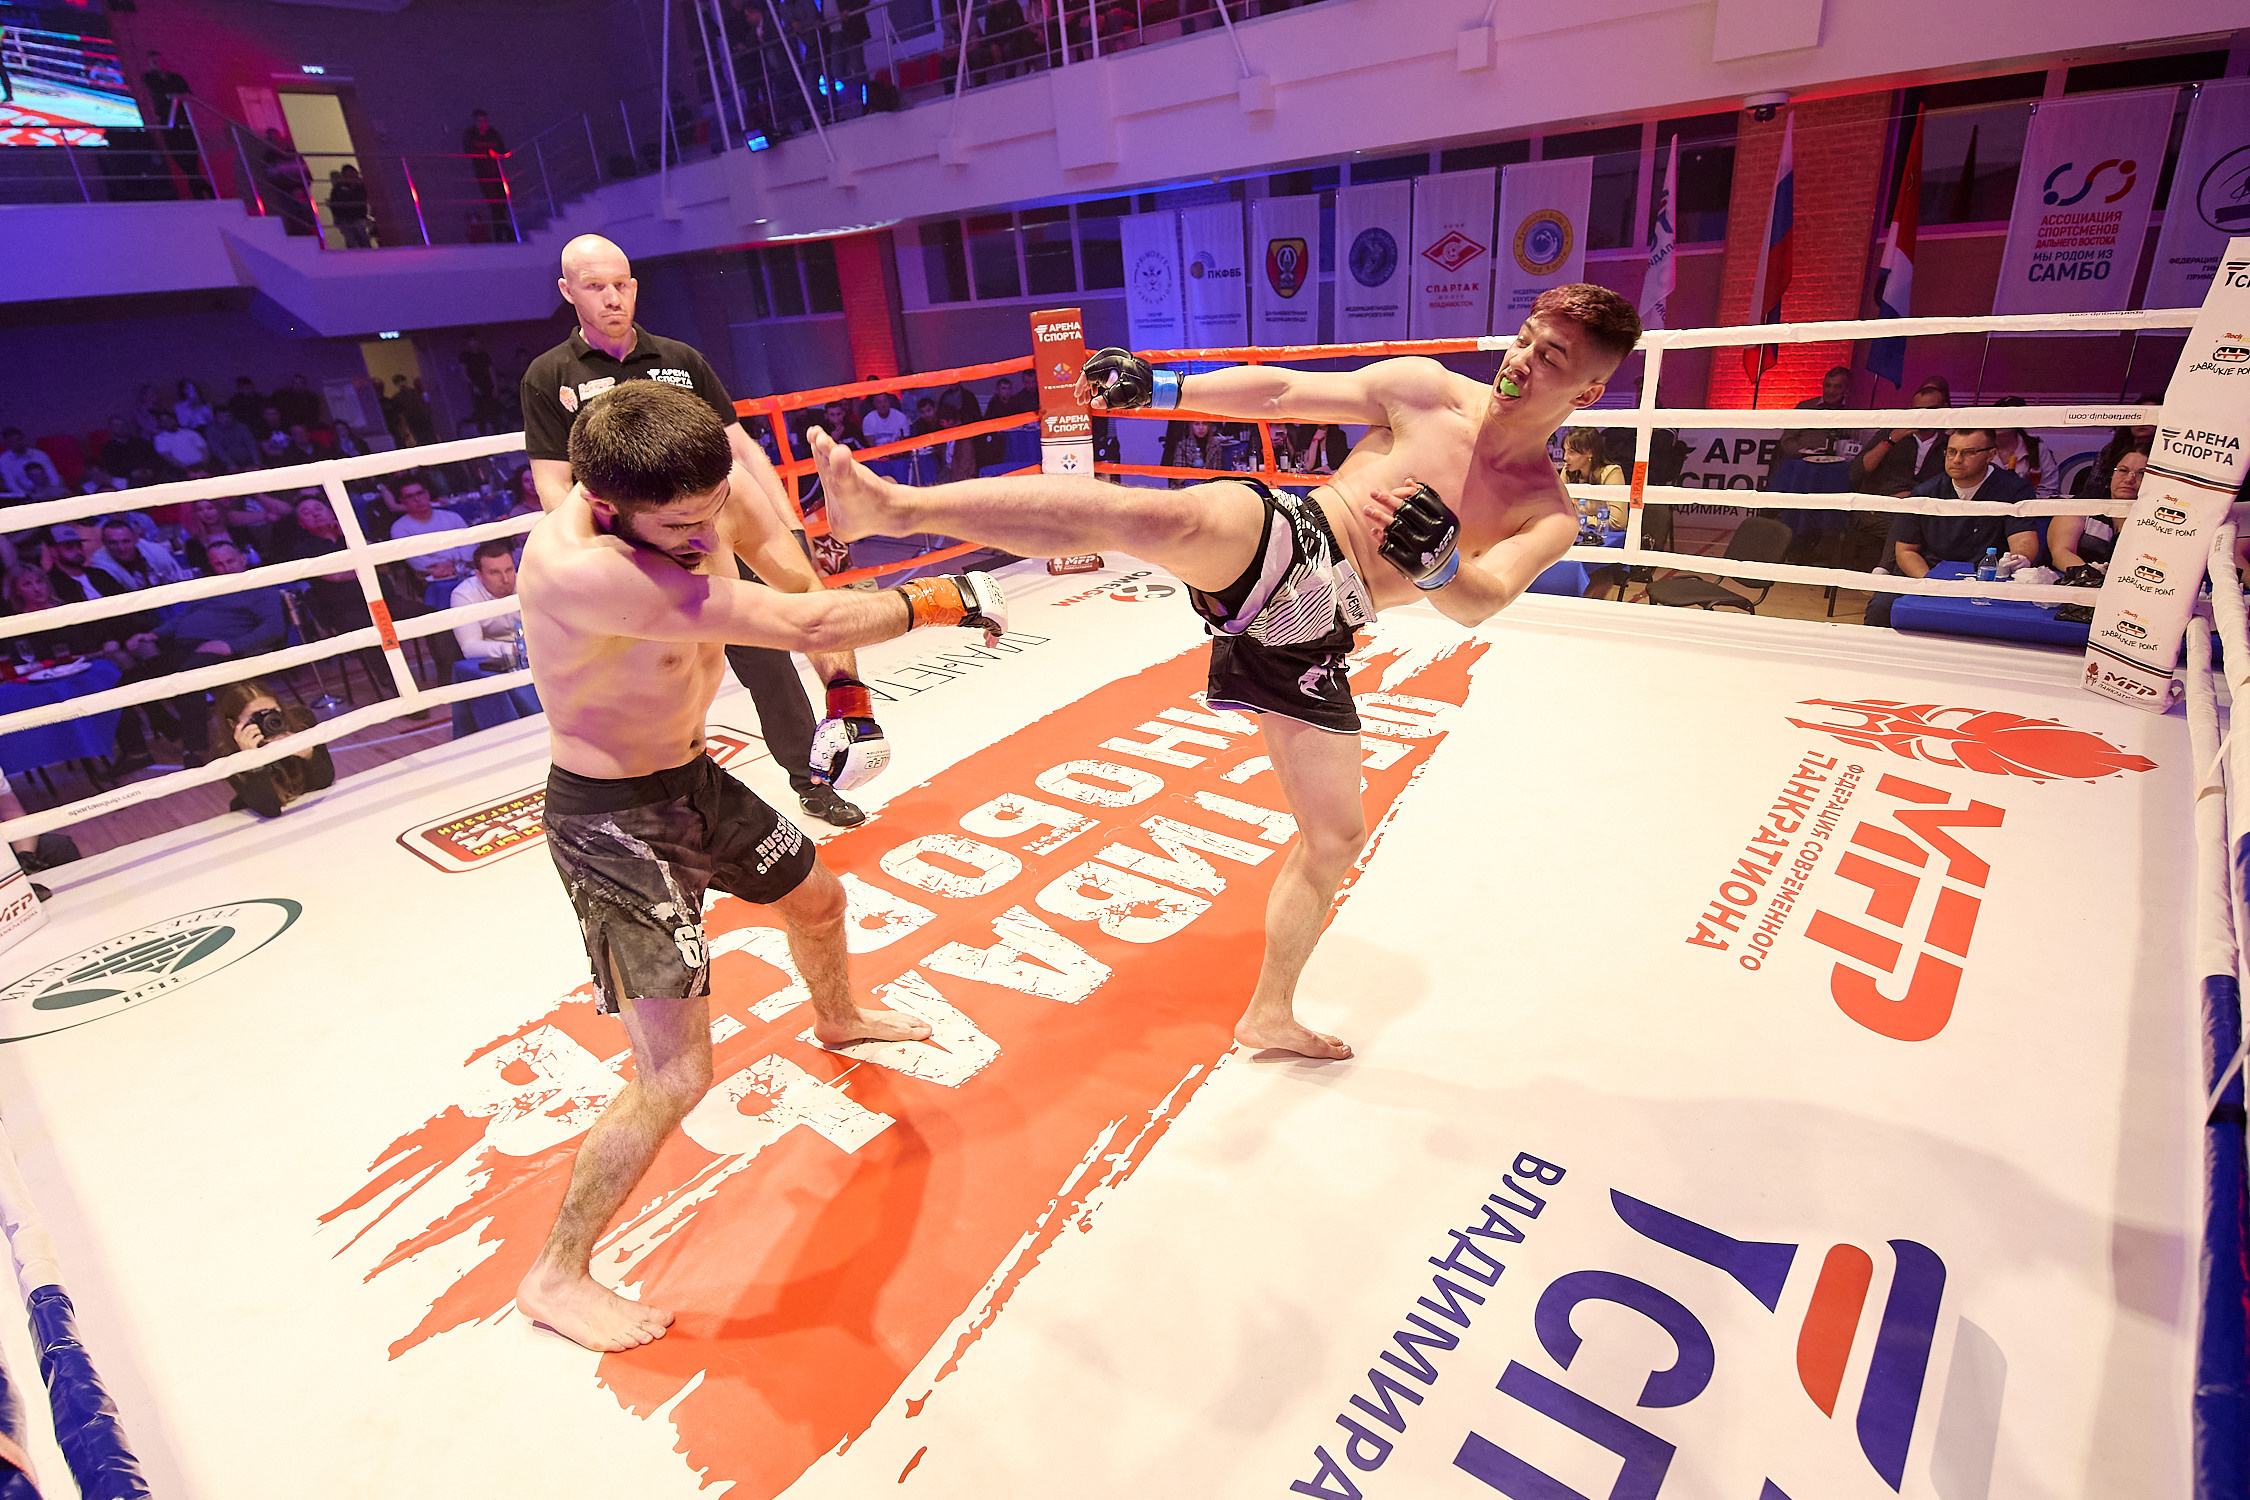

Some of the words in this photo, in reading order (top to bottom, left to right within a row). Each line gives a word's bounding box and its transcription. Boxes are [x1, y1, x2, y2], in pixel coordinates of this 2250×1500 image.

[2041, 210, 2123, 226] АССОЦИАЦИЯ
[2037, 223, 2120, 238] СПОРТСМЕНОВ
[2035, 238, 2078, 250] ДАЛЬНЕГО
[2078, 236, 2116, 247] ВОСТОКА
[2033, 251, 2051, 262] МЫ
[2054, 250, 2095, 261] РОДОМ
[2097, 249, 2114, 259] ИЗ
[2169, 256, 2218, 265] ФЕДЕРАЦИЯ
[1207, 267, 1242, 279] ПКФВБ
[2028, 260, 2111, 282] САМБО
[1425, 282, 1479, 294] СПАРТАК
[1048, 321, 1082, 332] АРЕНА
[1043, 331, 1083, 342] СПОРТА
[656, 375, 693, 386] СПОРТА
[661, 368, 691, 379] АРЕНА
[1059, 413, 1090, 424] АРЕНА
[2068, 412, 2142, 421] spartaequip.com
[1053, 422, 1091, 433] СПОРТА
[2184, 429, 2241, 450] АРЕНА
[1703, 437, 1779, 465] АРЕ
[1848, 445, 1859, 453] 18
[2172, 441, 2234, 466] СПОРТА
[1633, 464, 1645, 498] SPARTA
[2175, 528, 2198, 537] POINT
[1064, 554, 1096, 566] MFP
[1050, 570, 1153, 607] OMELGYM
[2154, 587, 2176, 596] POINT
[1344, 590, 1365, 621] VENUM
[2138, 642, 2159, 651] POINT
[2103, 671, 2157, 696] MFP
[1809, 763, 1866, 839] ФЕДЕРАЦИЯ
[437, 791, 546, 836] Т-МАГАЗИН
[472, 825, 543, 856] НЫЙ
[1685, 750, 1839, 952] ПАНКРАТИОНА
[1739, 840, 1824, 971] СОВРЕМЕННОГО
[1804, 772, 2007, 1042] MFP
[2, 907, 241, 1002] ТЕРЕХОВСКИЙ
[1290, 1151, 1567, 1500] ВЛАДИМИРА
